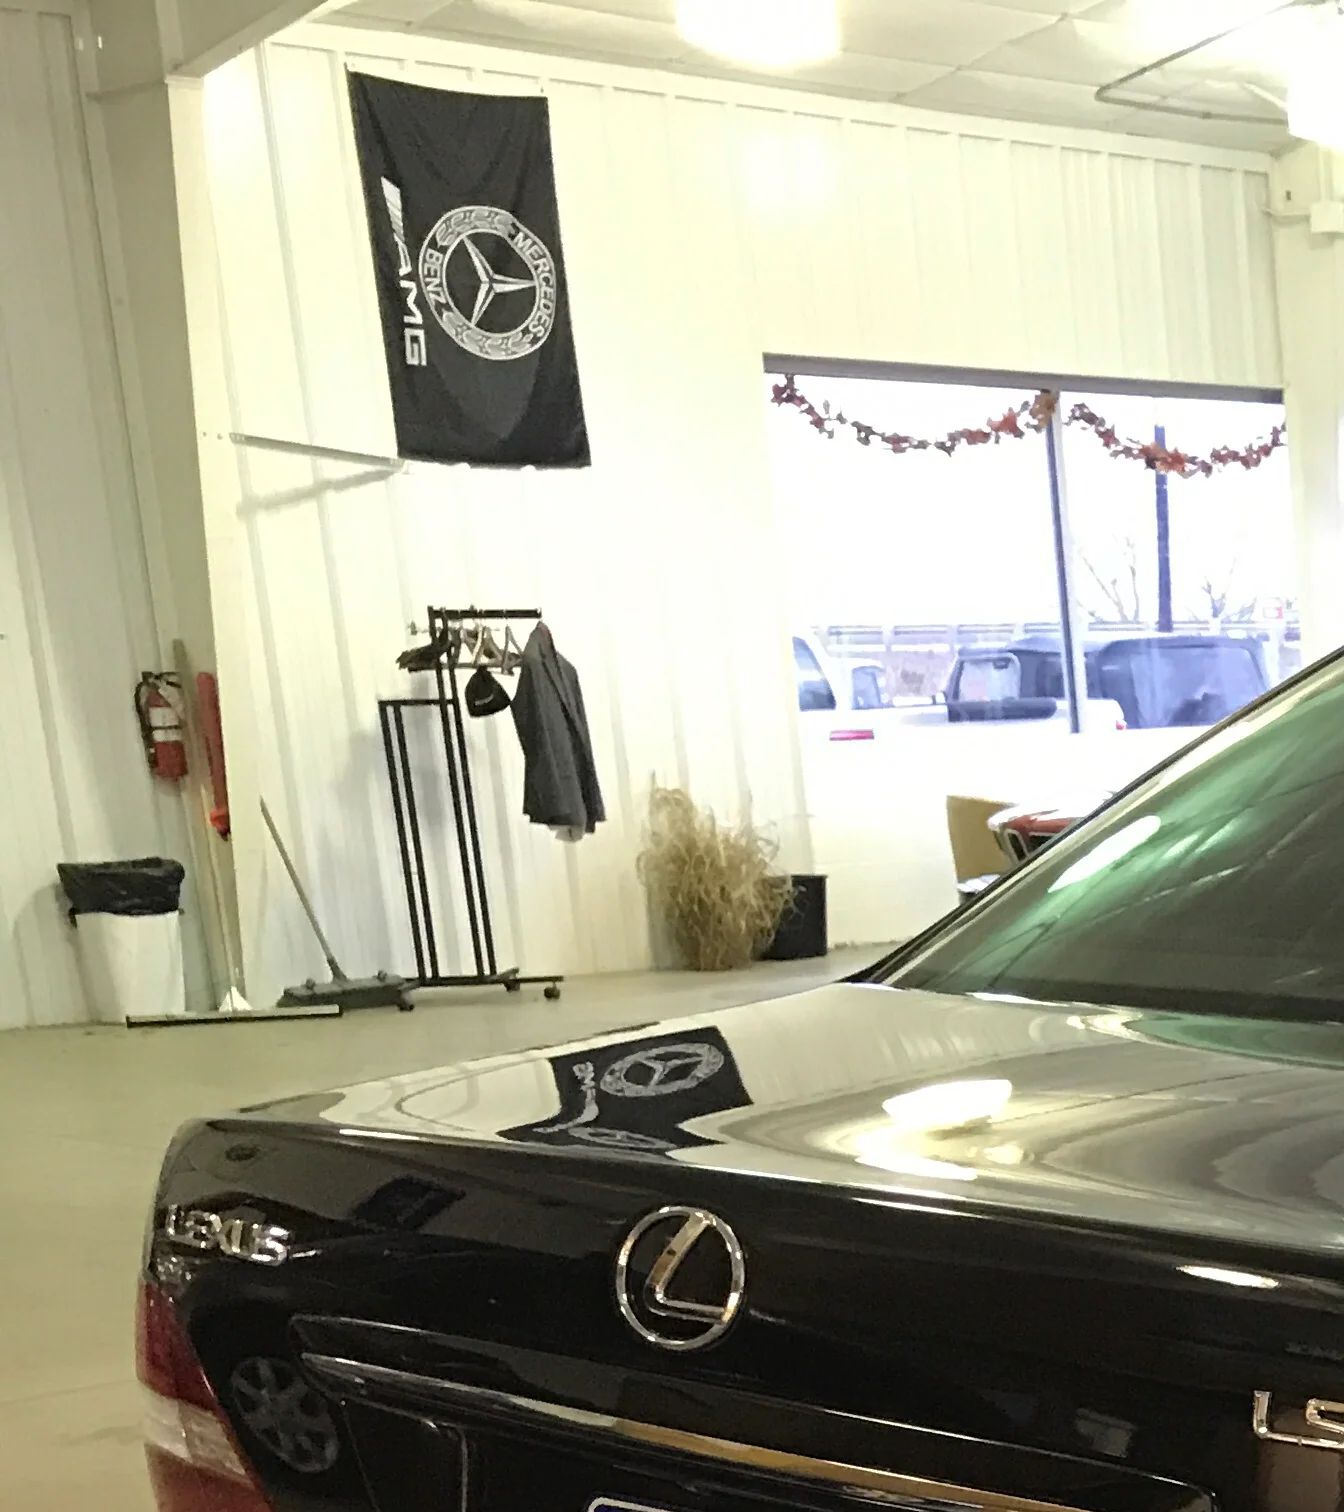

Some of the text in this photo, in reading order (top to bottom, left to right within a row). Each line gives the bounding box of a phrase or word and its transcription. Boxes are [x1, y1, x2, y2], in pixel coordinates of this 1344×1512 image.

[393, 232, 428, 367] AMG
[423, 247, 447, 305] BENZ
[513, 231, 555, 338] MERCEDES
